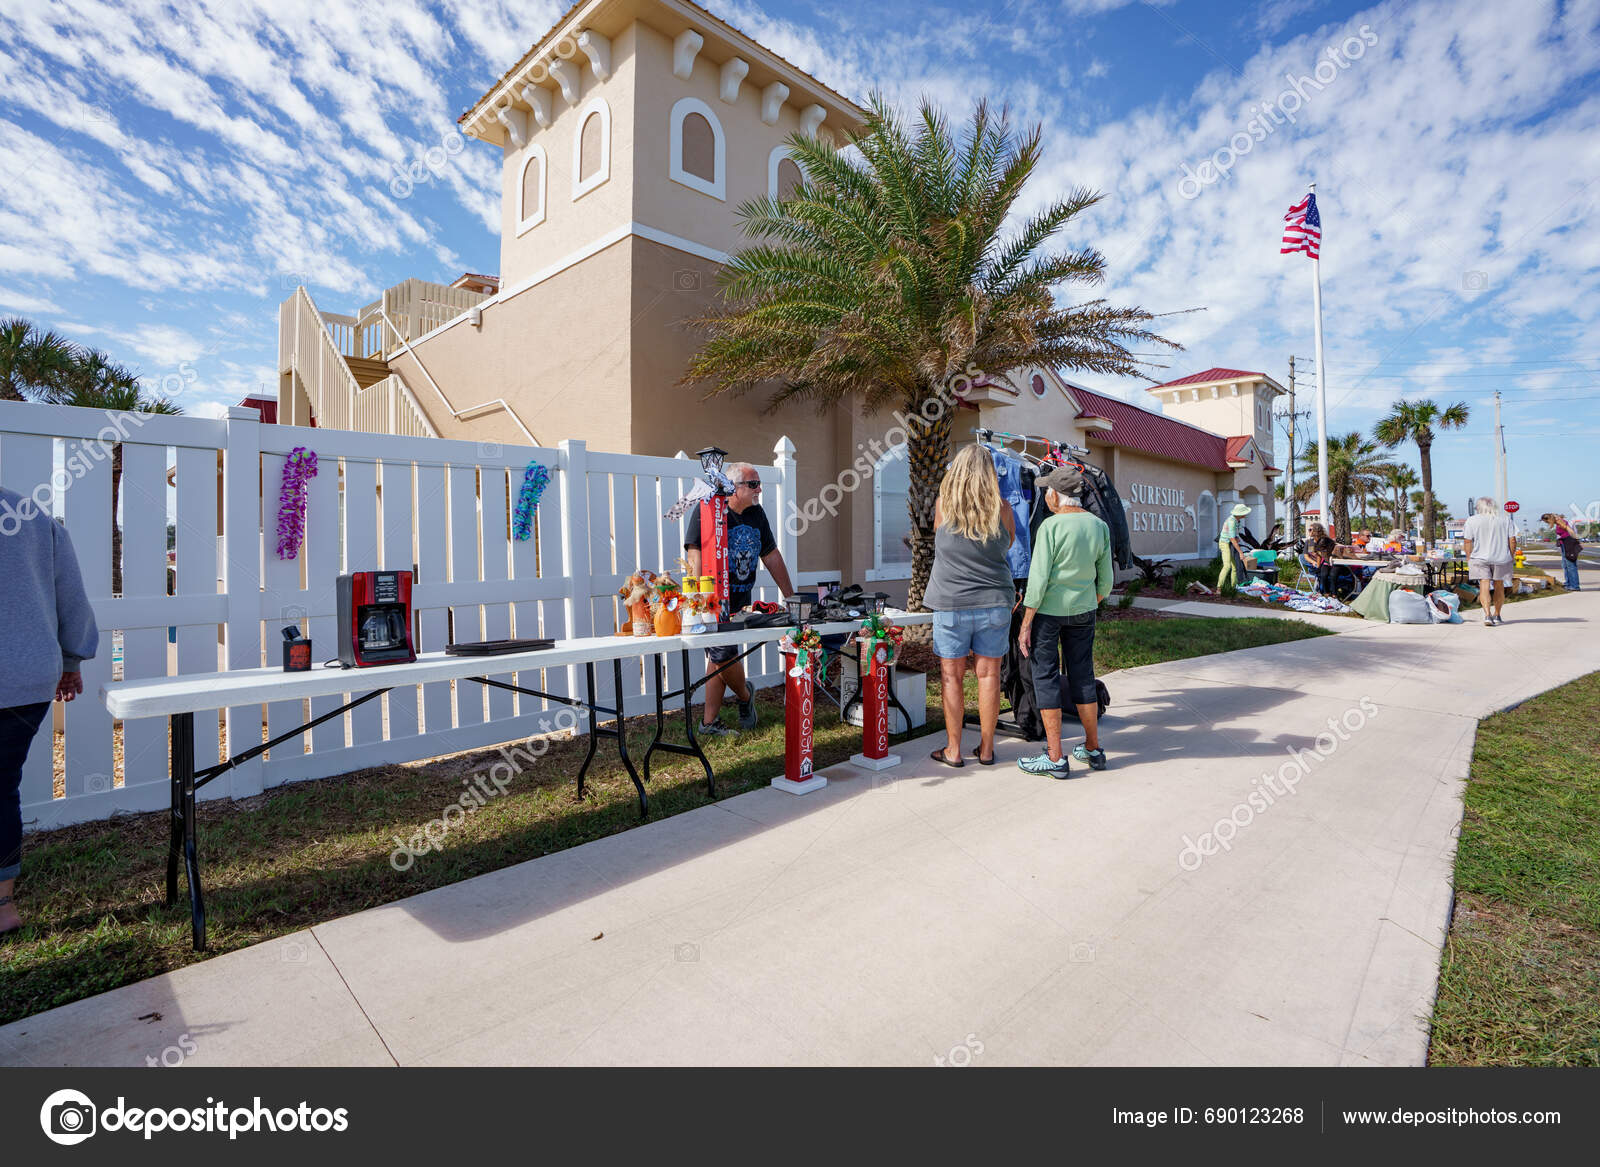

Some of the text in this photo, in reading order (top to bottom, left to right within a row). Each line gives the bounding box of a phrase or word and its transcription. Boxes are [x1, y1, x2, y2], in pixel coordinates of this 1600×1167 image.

[1130, 483, 1184, 508] SURFSIDE
[715, 498, 723, 559] Sammy's
[1132, 511, 1184, 532] ESTATES
[876, 666, 887, 752] PEACE
